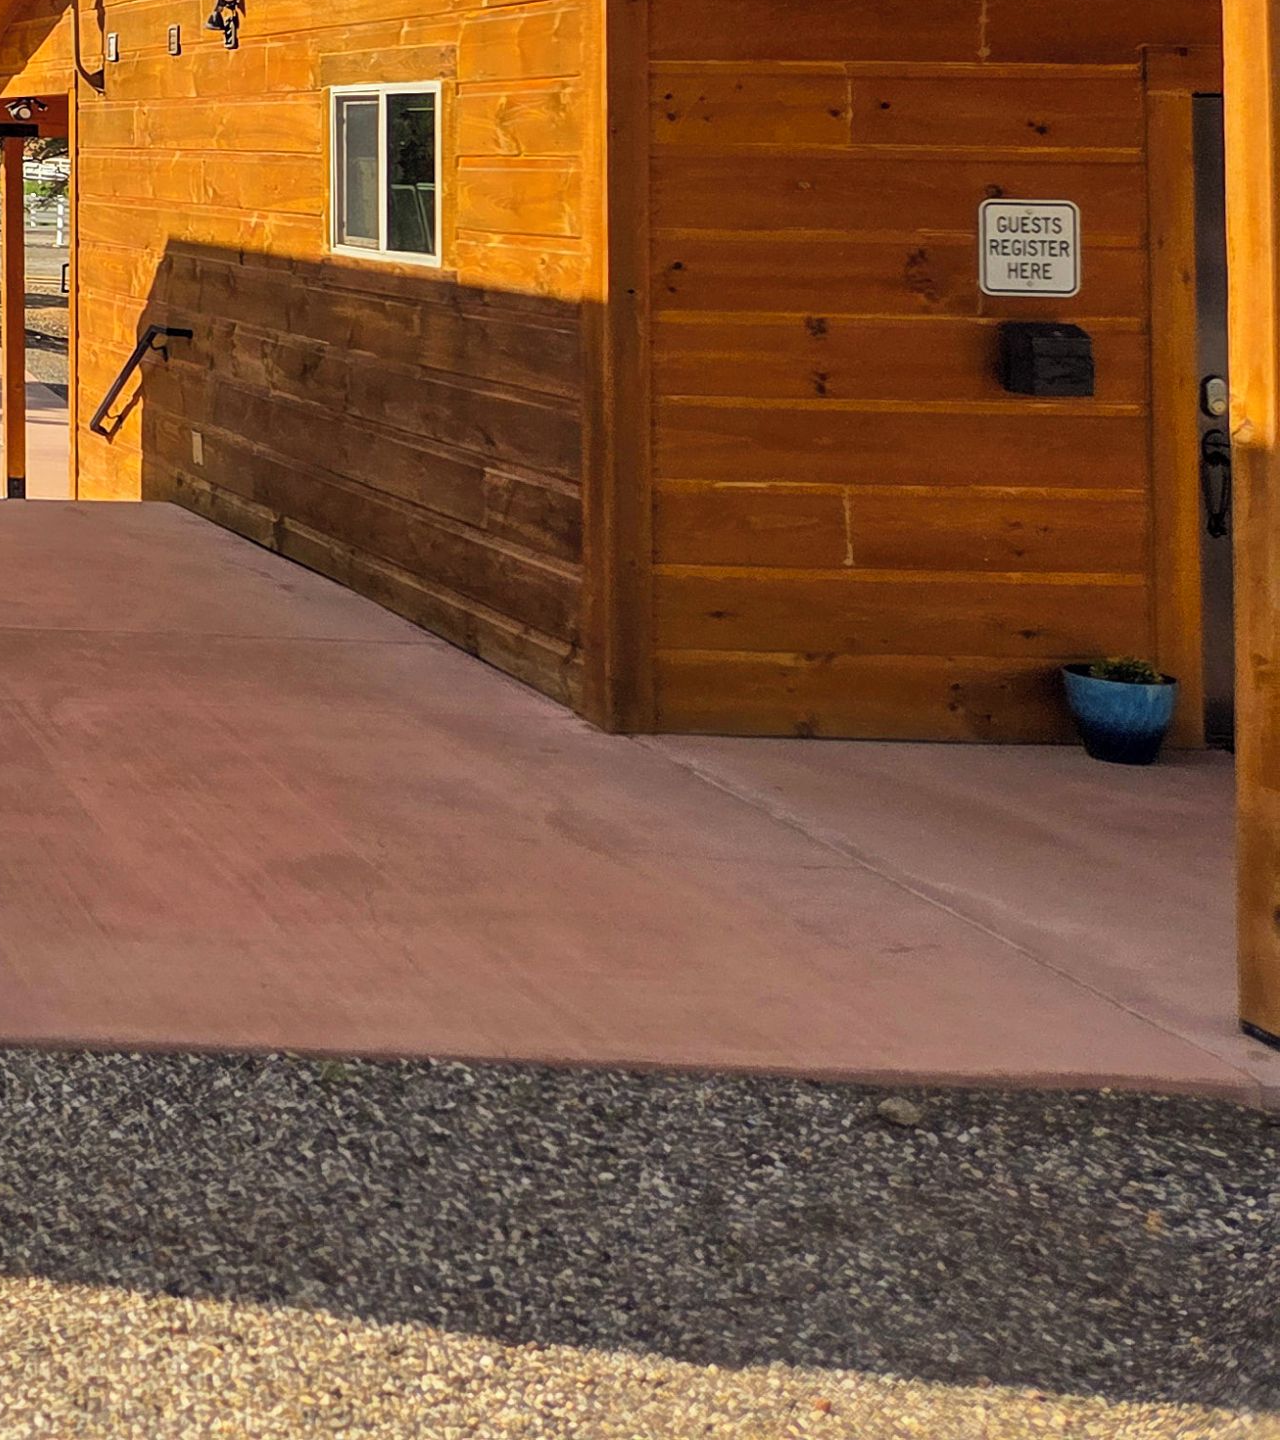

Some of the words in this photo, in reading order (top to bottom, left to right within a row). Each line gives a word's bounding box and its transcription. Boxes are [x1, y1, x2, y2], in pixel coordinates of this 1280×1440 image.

[996, 216, 1063, 234] GUESTS
[989, 239, 1070, 258] REGISTER
[1007, 262, 1053, 280] HERE
